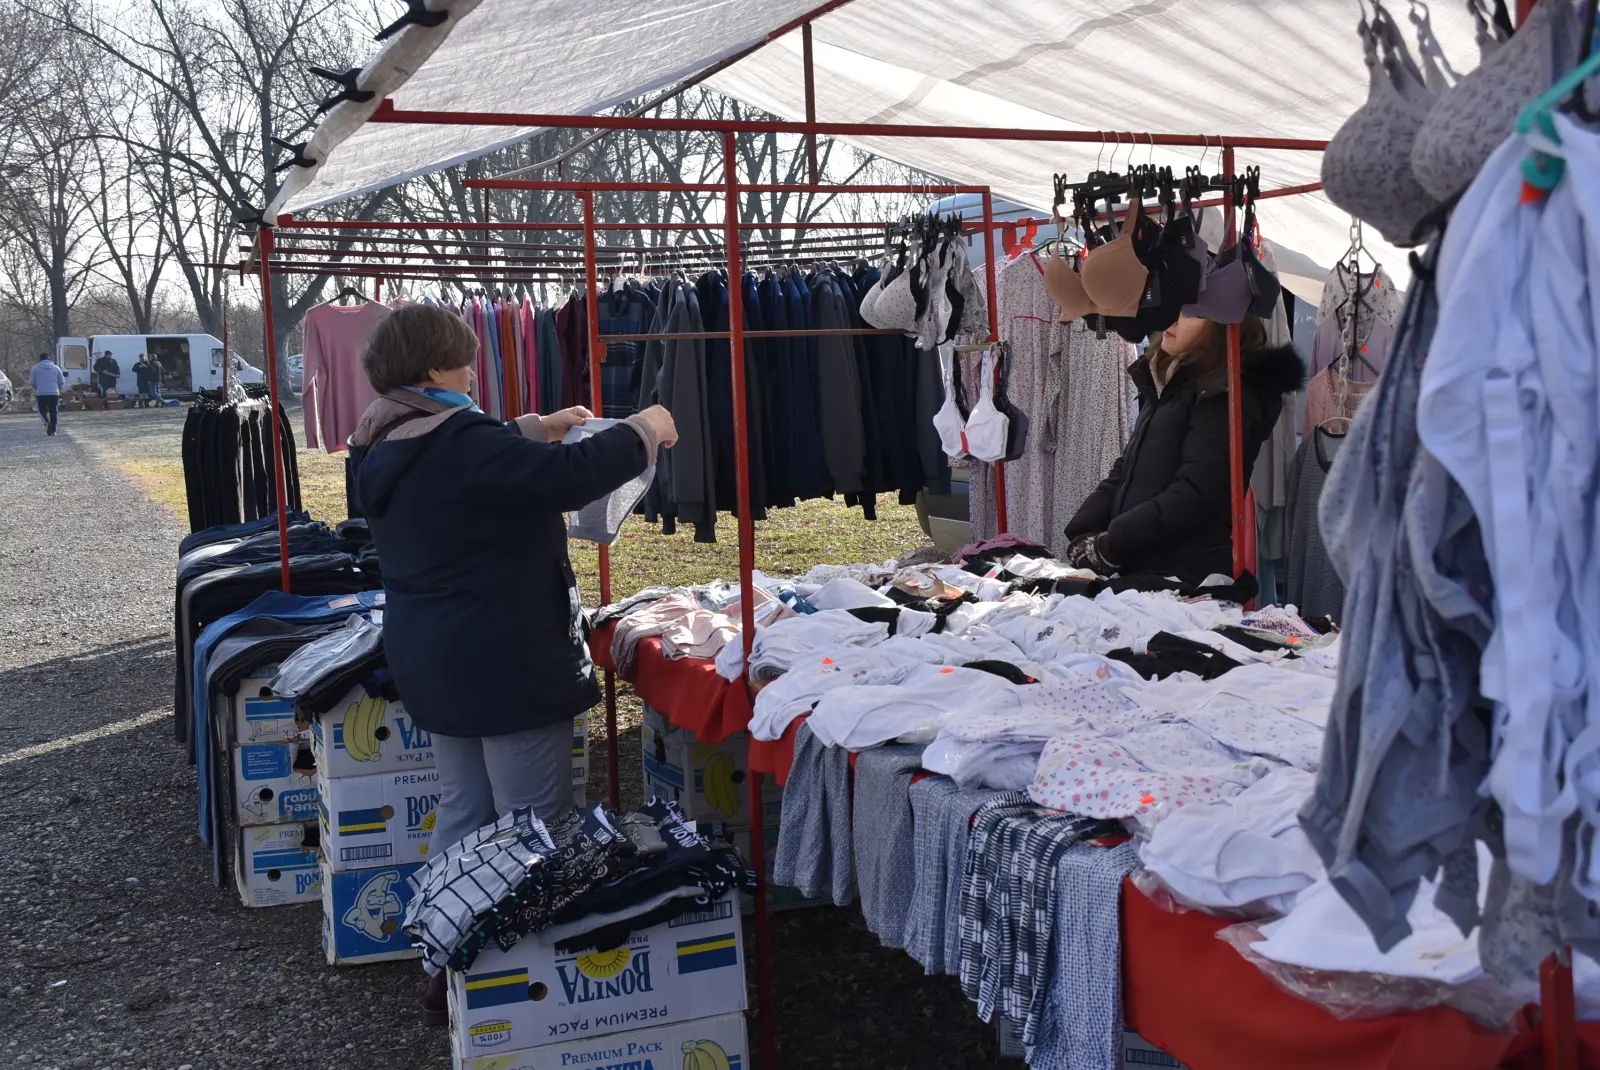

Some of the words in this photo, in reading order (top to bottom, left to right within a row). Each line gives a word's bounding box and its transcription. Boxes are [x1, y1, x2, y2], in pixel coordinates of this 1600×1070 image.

[279, 830, 306, 838] PREM
[555, 950, 654, 1005] BONITA
[548, 1018, 590, 1037] PACK
[595, 1004, 668, 1029] PREMIUM
[479, 1033, 503, 1043] 100%
[561, 1047, 623, 1067] PREMIUM
[627, 1041, 664, 1056] PACK
